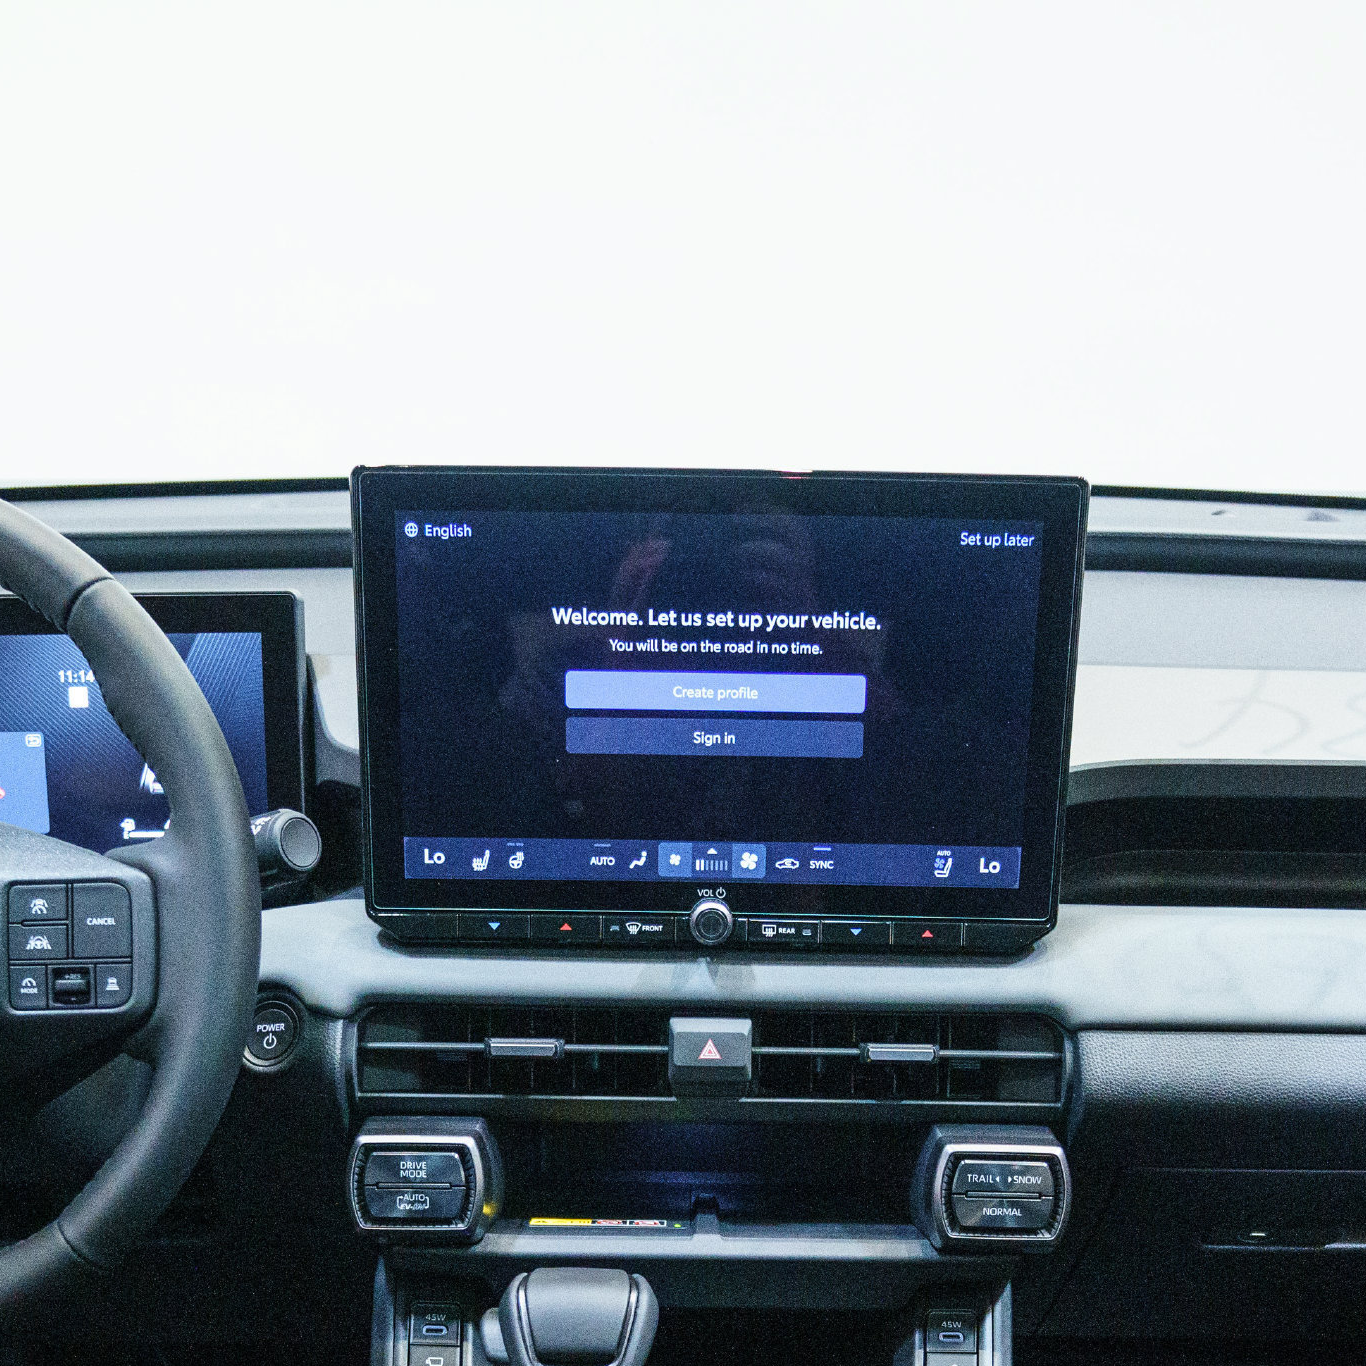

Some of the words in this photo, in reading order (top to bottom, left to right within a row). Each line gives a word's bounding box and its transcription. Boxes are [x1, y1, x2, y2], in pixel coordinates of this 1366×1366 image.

[425, 523, 472, 540] English
[960, 532, 982, 546] Set
[984, 535, 1002, 549] up
[1004, 532, 1035, 547] later
[551, 607, 644, 626] Welcome.
[648, 608, 677, 627] Let
[681, 613, 702, 627] us
[706, 611, 735, 627] set
[738, 613, 763, 632] up
[766, 614, 808, 632] your
[811, 611, 882, 631] vehicle.
[609, 638, 634, 652] You
[636, 638, 659, 652] will
[661, 639, 678, 652] be
[680, 642, 697, 653] on
[700, 640, 722, 653] the
[724, 640, 754, 653] road
[756, 641, 768, 654] in
[771, 643, 788, 655] no
[791, 642, 823, 655] time.
[672, 686, 715, 699] Create
[717, 686, 759, 701] profile
[692, 731, 721, 747] Sign
[724, 731, 736, 745] in
[423, 848, 446, 865] Lo
[589, 856, 616, 867] AUTO
[809, 860, 835, 870] SYNC
[979, 857, 1001, 874] Lo
[696, 888, 715, 898] VOL
[86, 917, 116, 926] CANCEL
[641, 924, 664, 933] FRONT
[778, 926, 796, 935] REAR
[256, 1022, 286, 1033] POWER
[399, 1161, 427, 1170] DRIVE
[399, 1169, 427, 1179] MODE
[967, 1174, 994, 1184] TRAIL
[1013, 1175, 1042, 1185] SNOW
[402, 1192, 426, 1202] AUTO
[982, 1207, 1023, 1216] NORMAL
